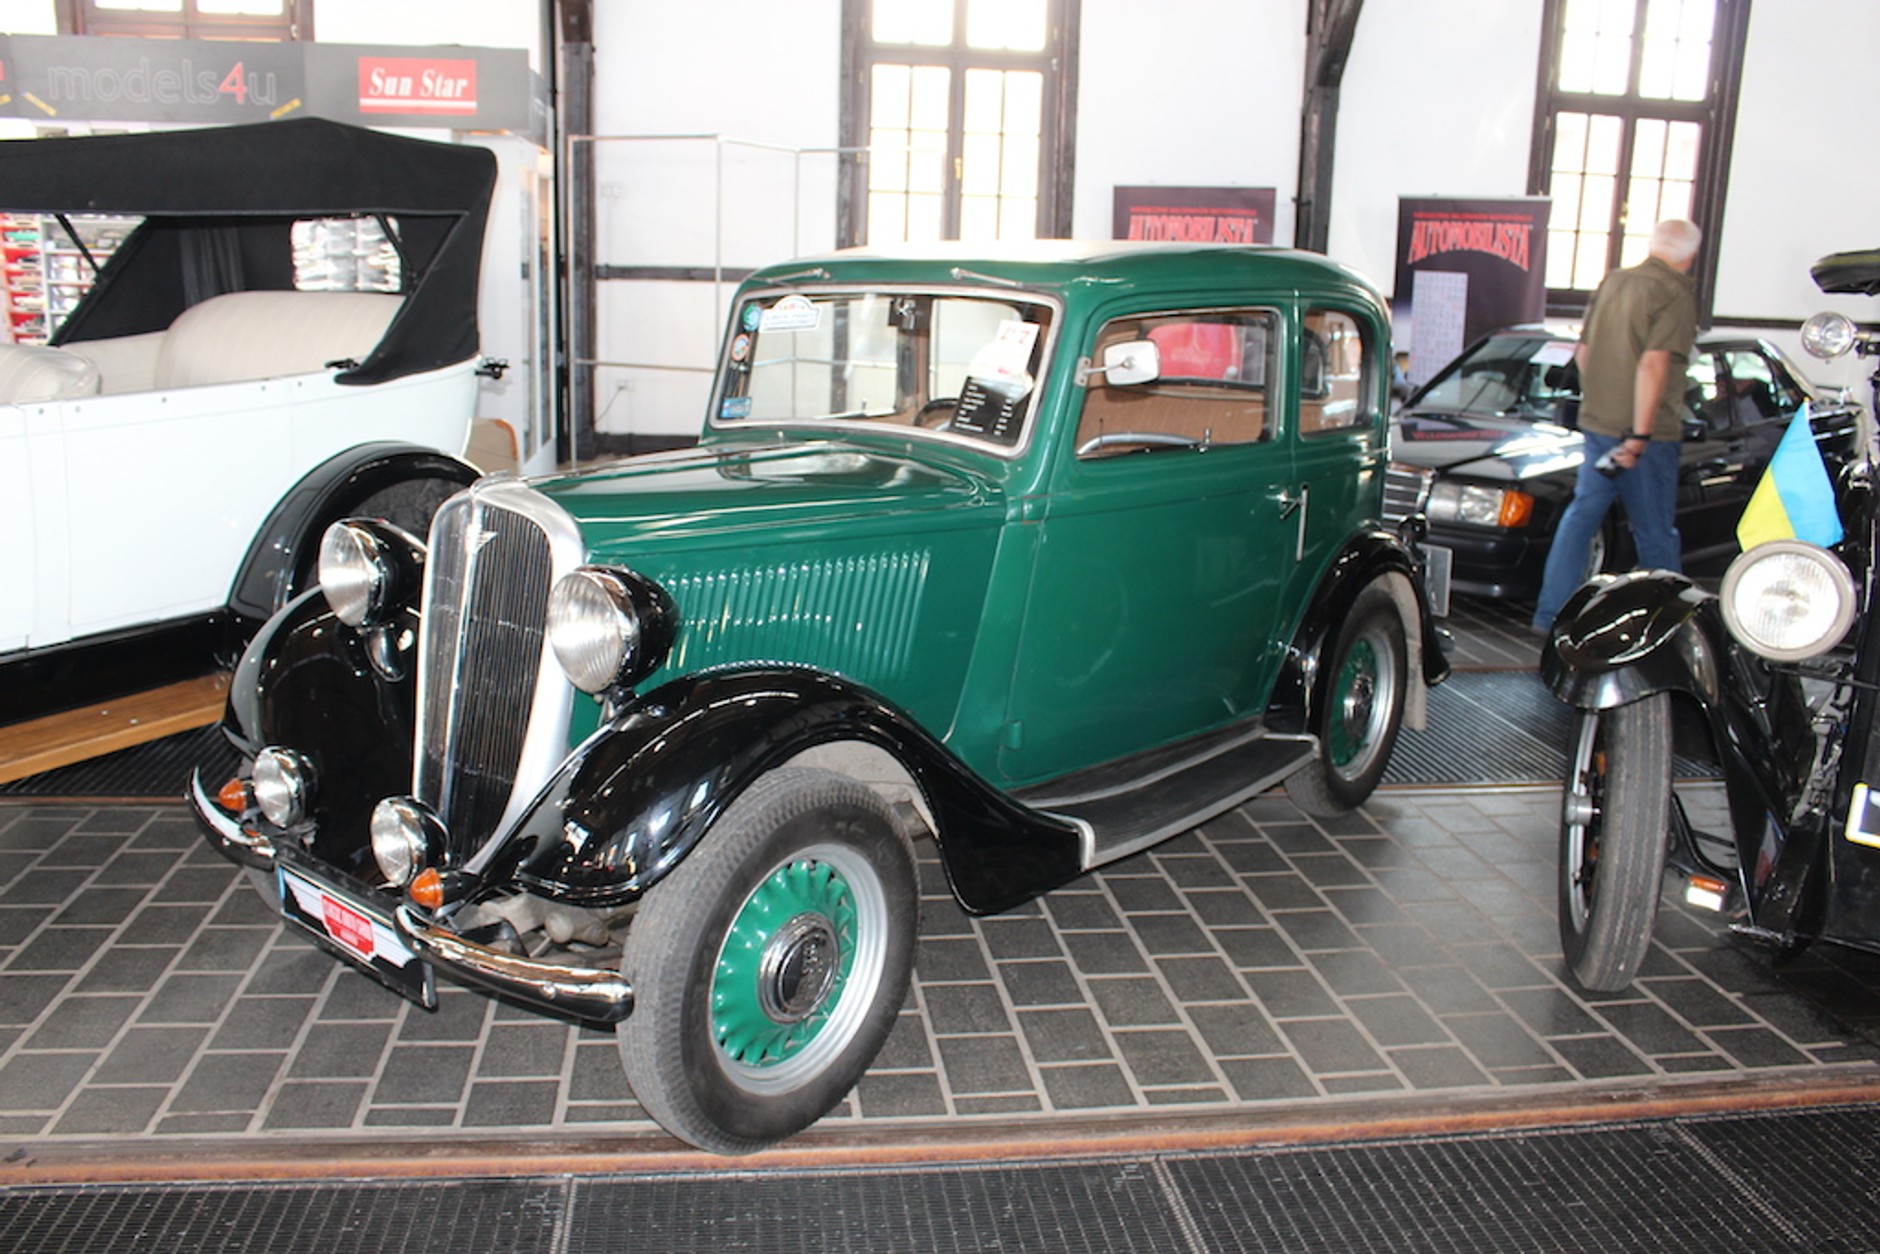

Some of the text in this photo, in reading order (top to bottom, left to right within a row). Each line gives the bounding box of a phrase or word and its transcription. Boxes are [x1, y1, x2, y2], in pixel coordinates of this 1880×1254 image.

[47, 57, 276, 105] models4u
[369, 66, 468, 98] Sun Star
[1407, 220, 1530, 272] AUTOMOBILISTA
